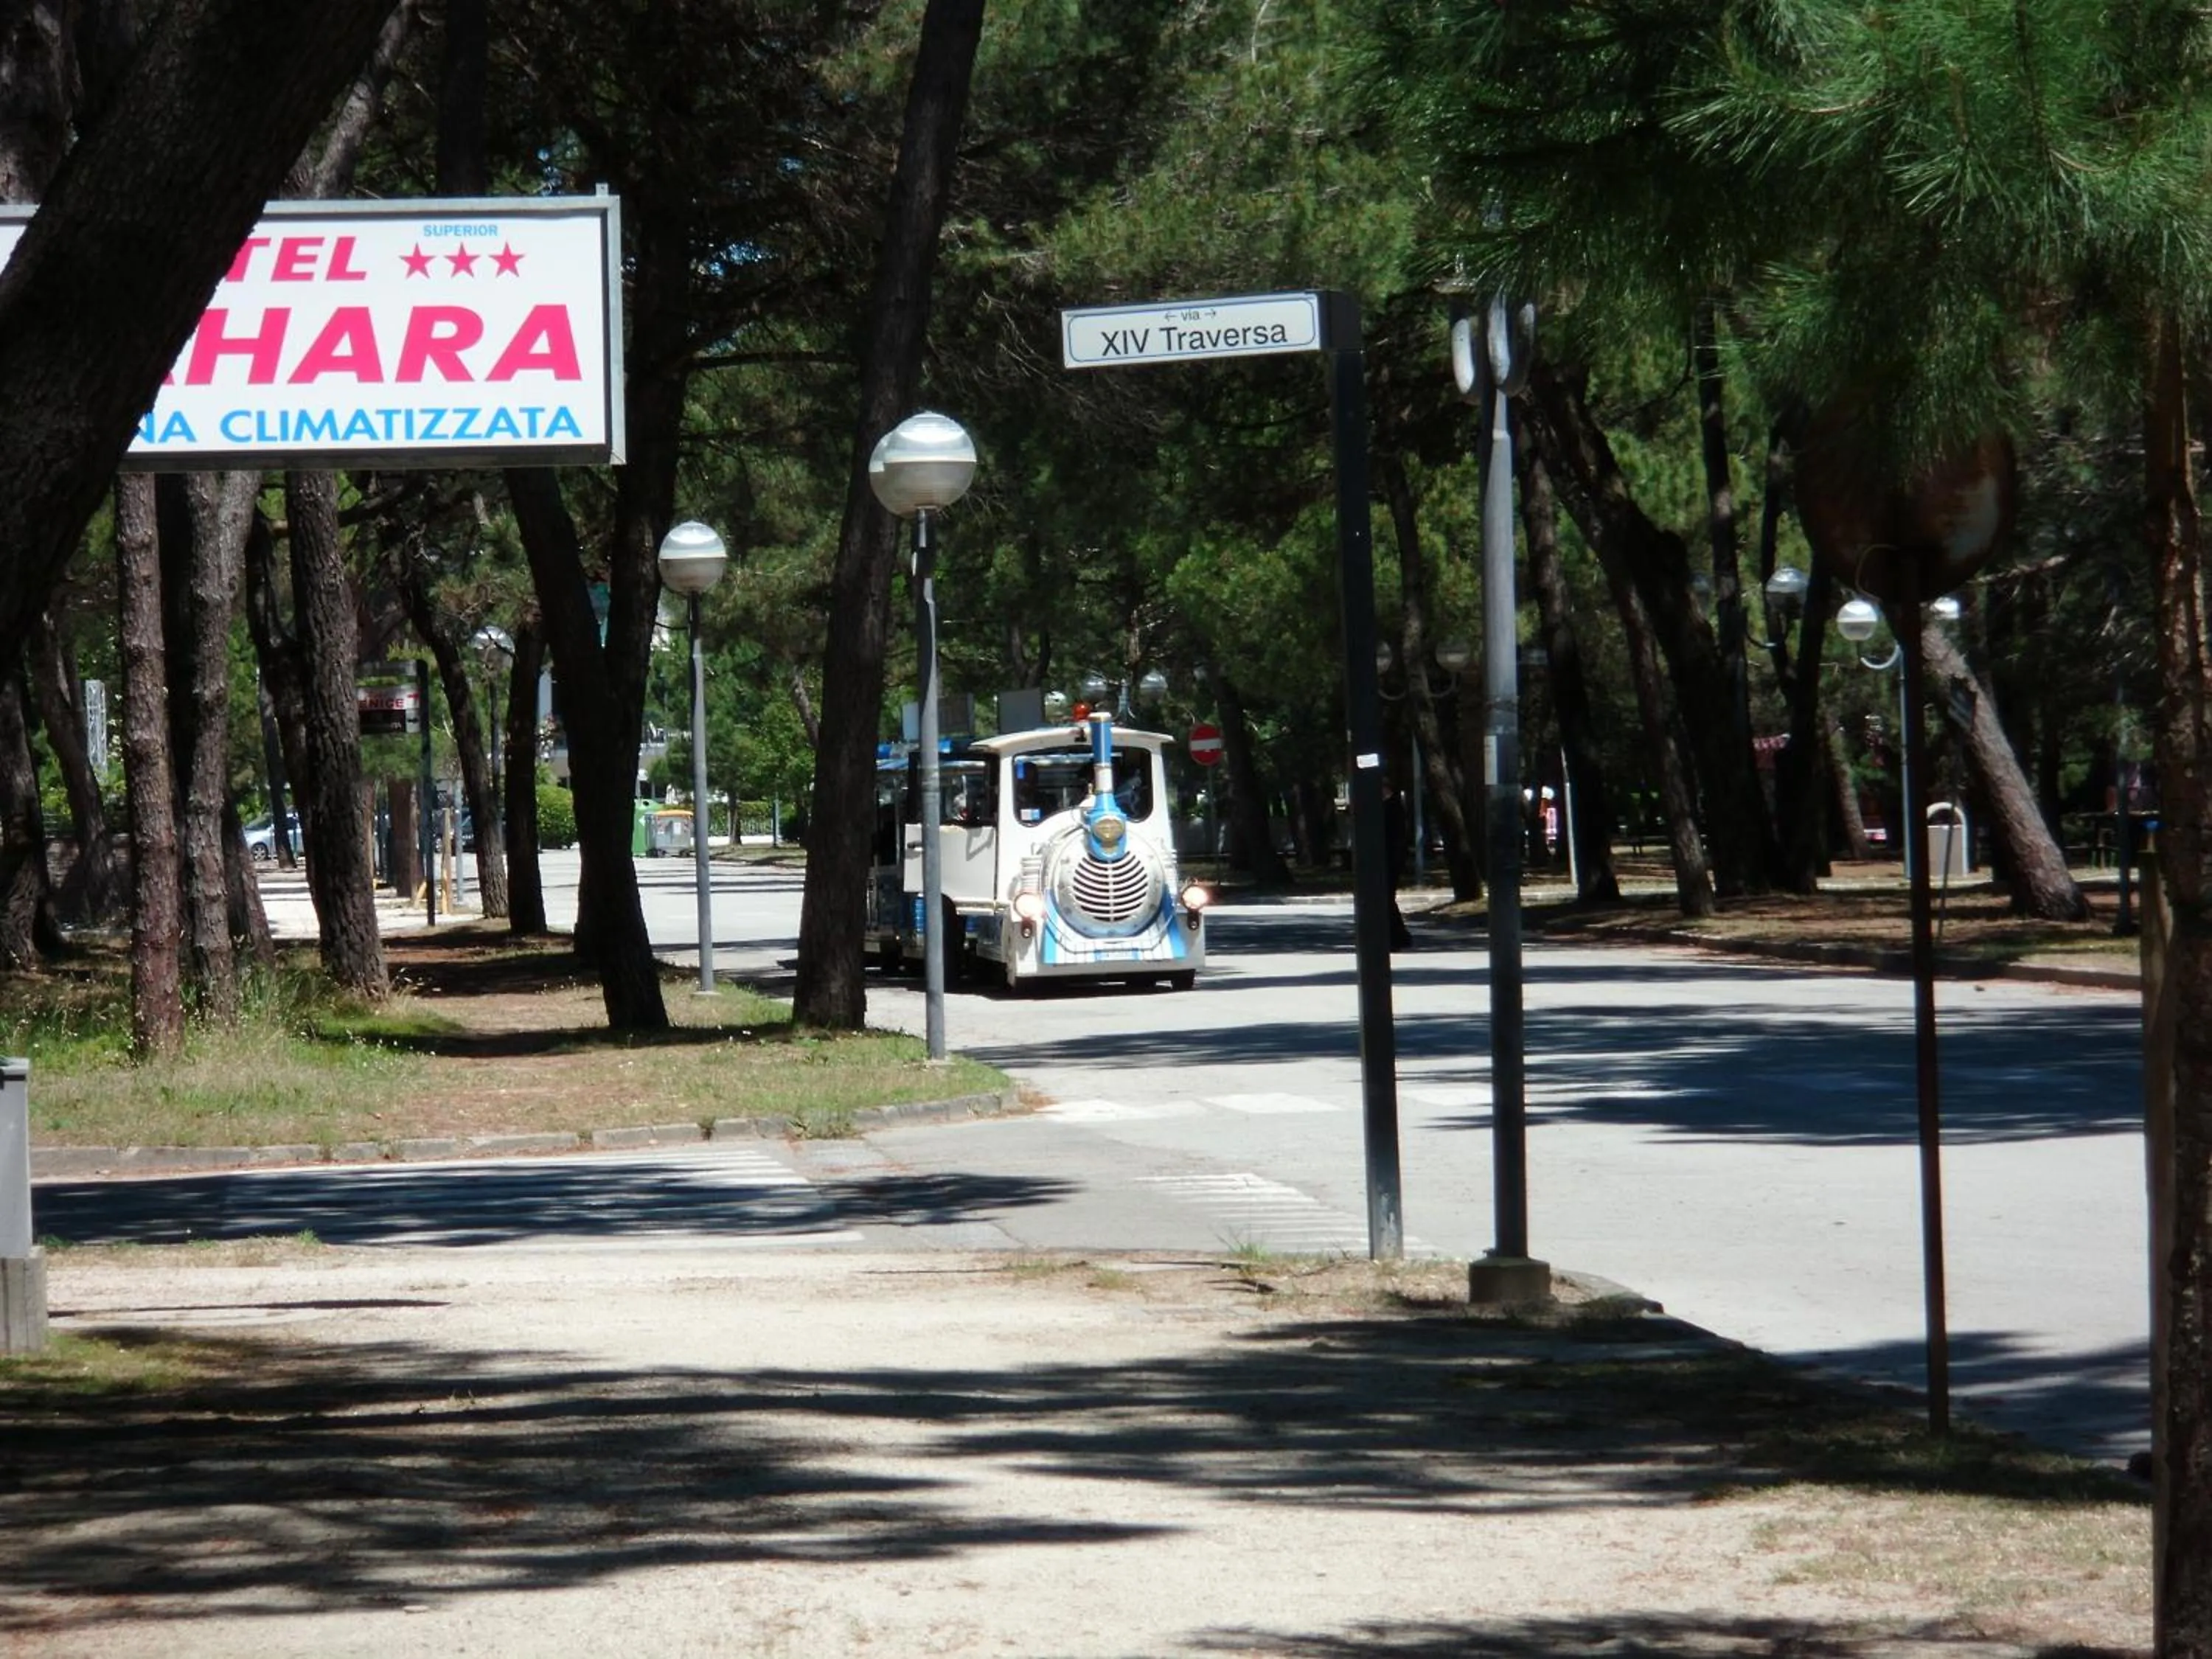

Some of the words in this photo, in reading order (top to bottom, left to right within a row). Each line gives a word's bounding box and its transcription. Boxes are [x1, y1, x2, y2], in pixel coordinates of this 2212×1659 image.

[422, 225, 498, 237] SUPERIOR
[223, 237, 367, 282] TEL
[1180, 308, 1201, 321] via
[161, 303, 582, 385] HARA
[1101, 329, 1150, 356] XIV
[1158, 323, 1288, 352] Traversa
[136, 409, 197, 444] NA
[220, 406, 583, 444] CLIMATIZZATA
